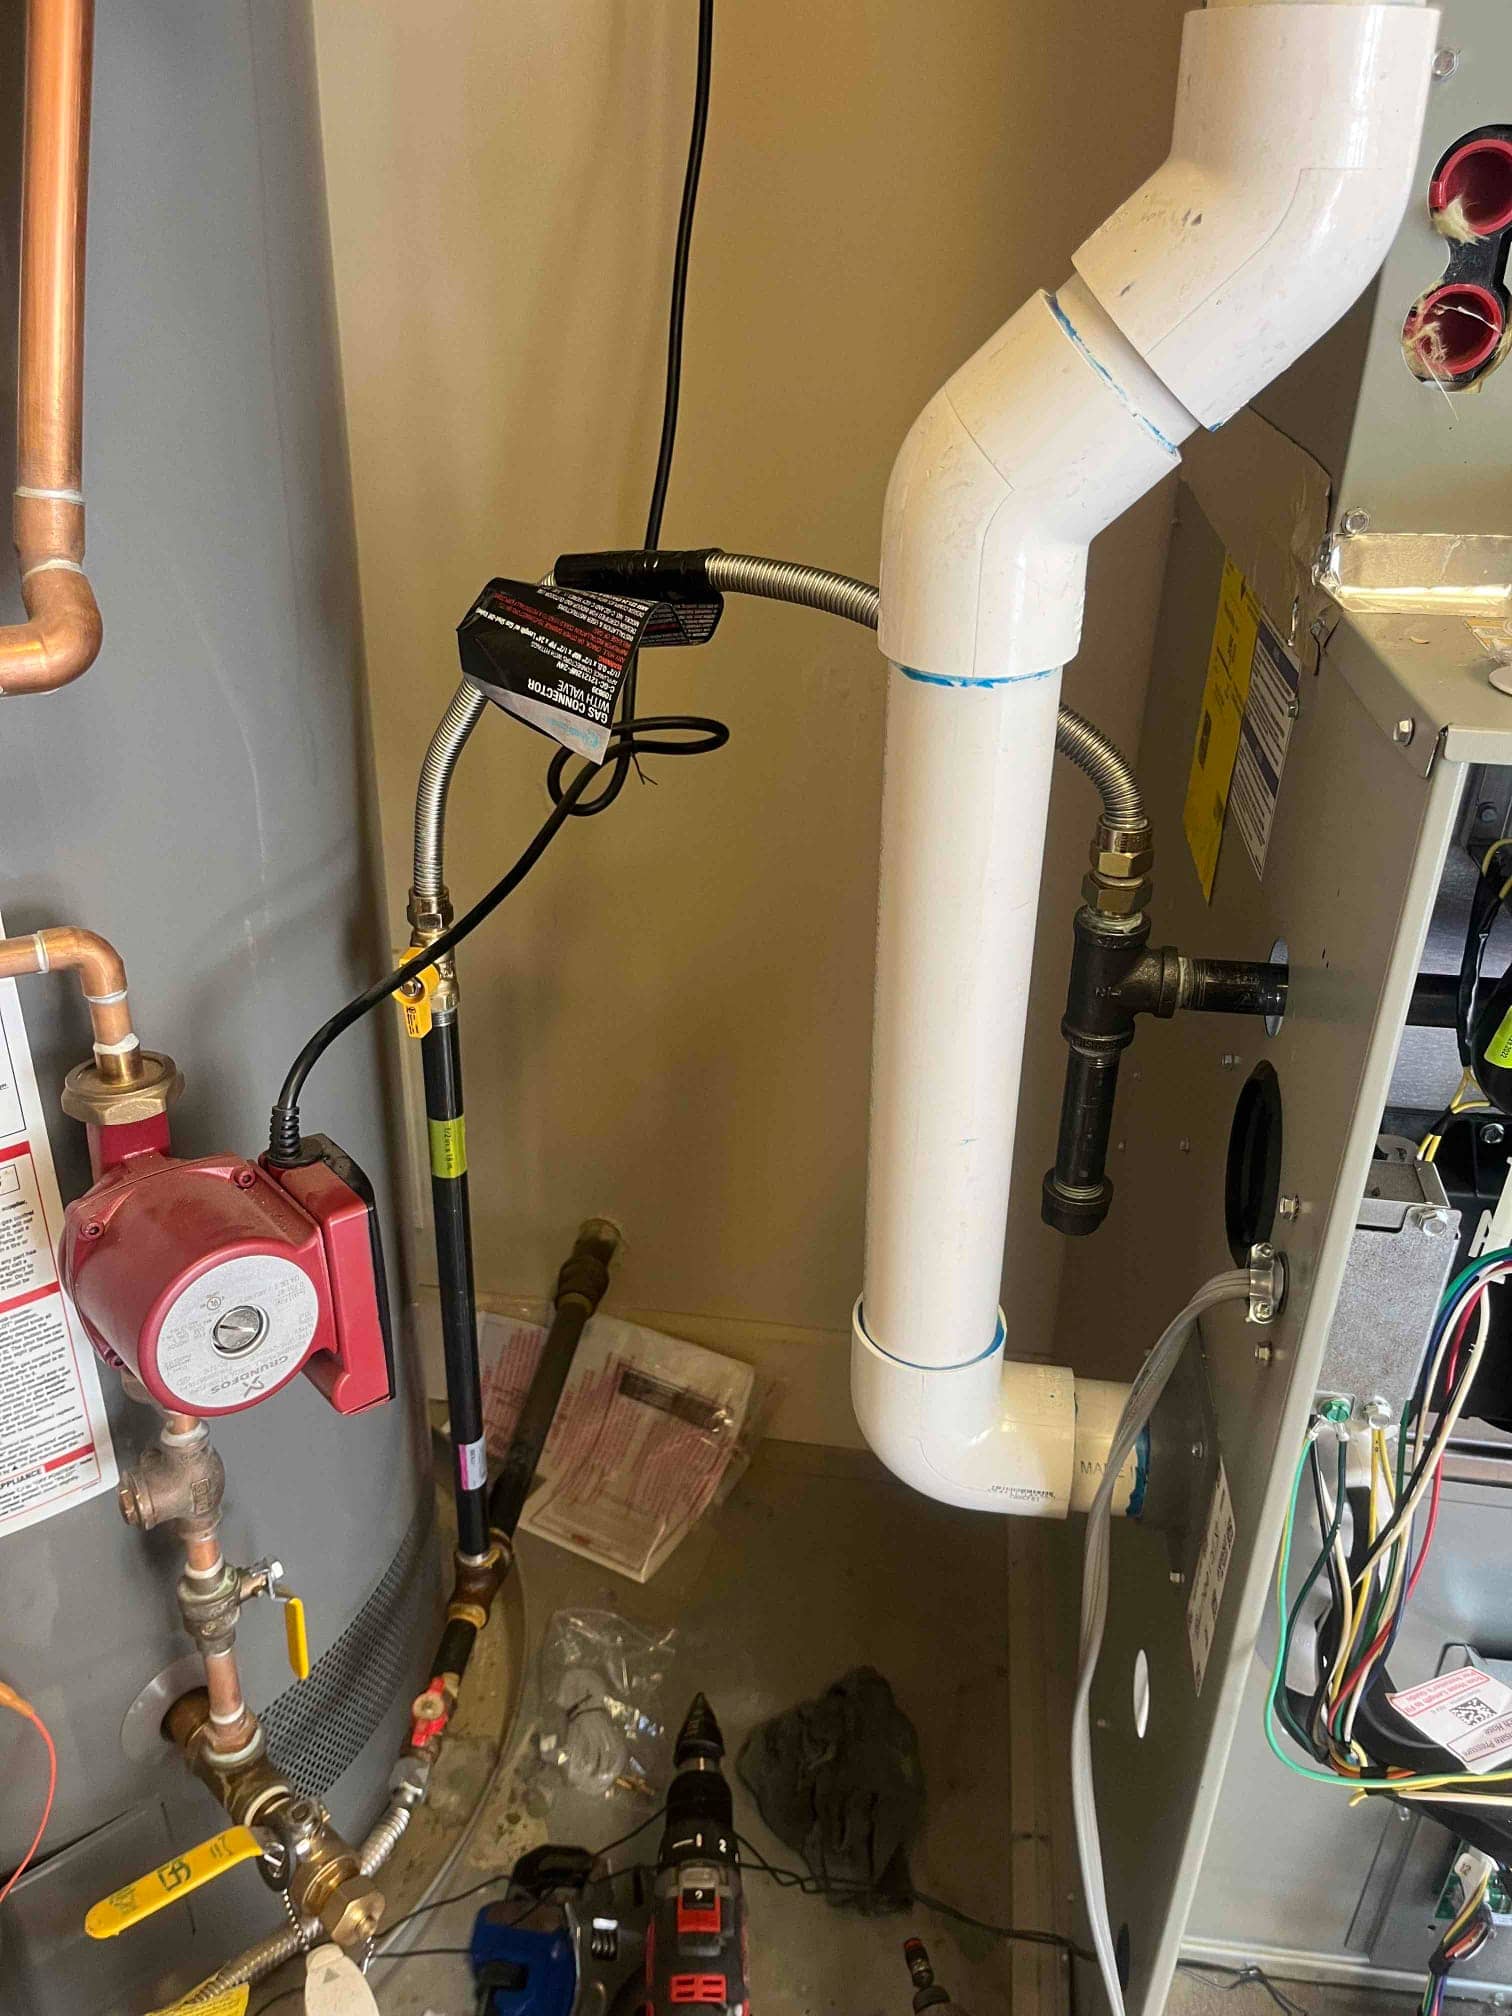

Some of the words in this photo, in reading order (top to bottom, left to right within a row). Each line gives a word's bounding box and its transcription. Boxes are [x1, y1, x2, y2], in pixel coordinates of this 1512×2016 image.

[525, 677, 586, 713] CONNECTOR
[555, 678, 586, 701] VALVE
[584, 692, 612, 713] WITH
[586, 705, 609, 724] GAS
[208, 1353, 289, 1395] GRUNDFOS
